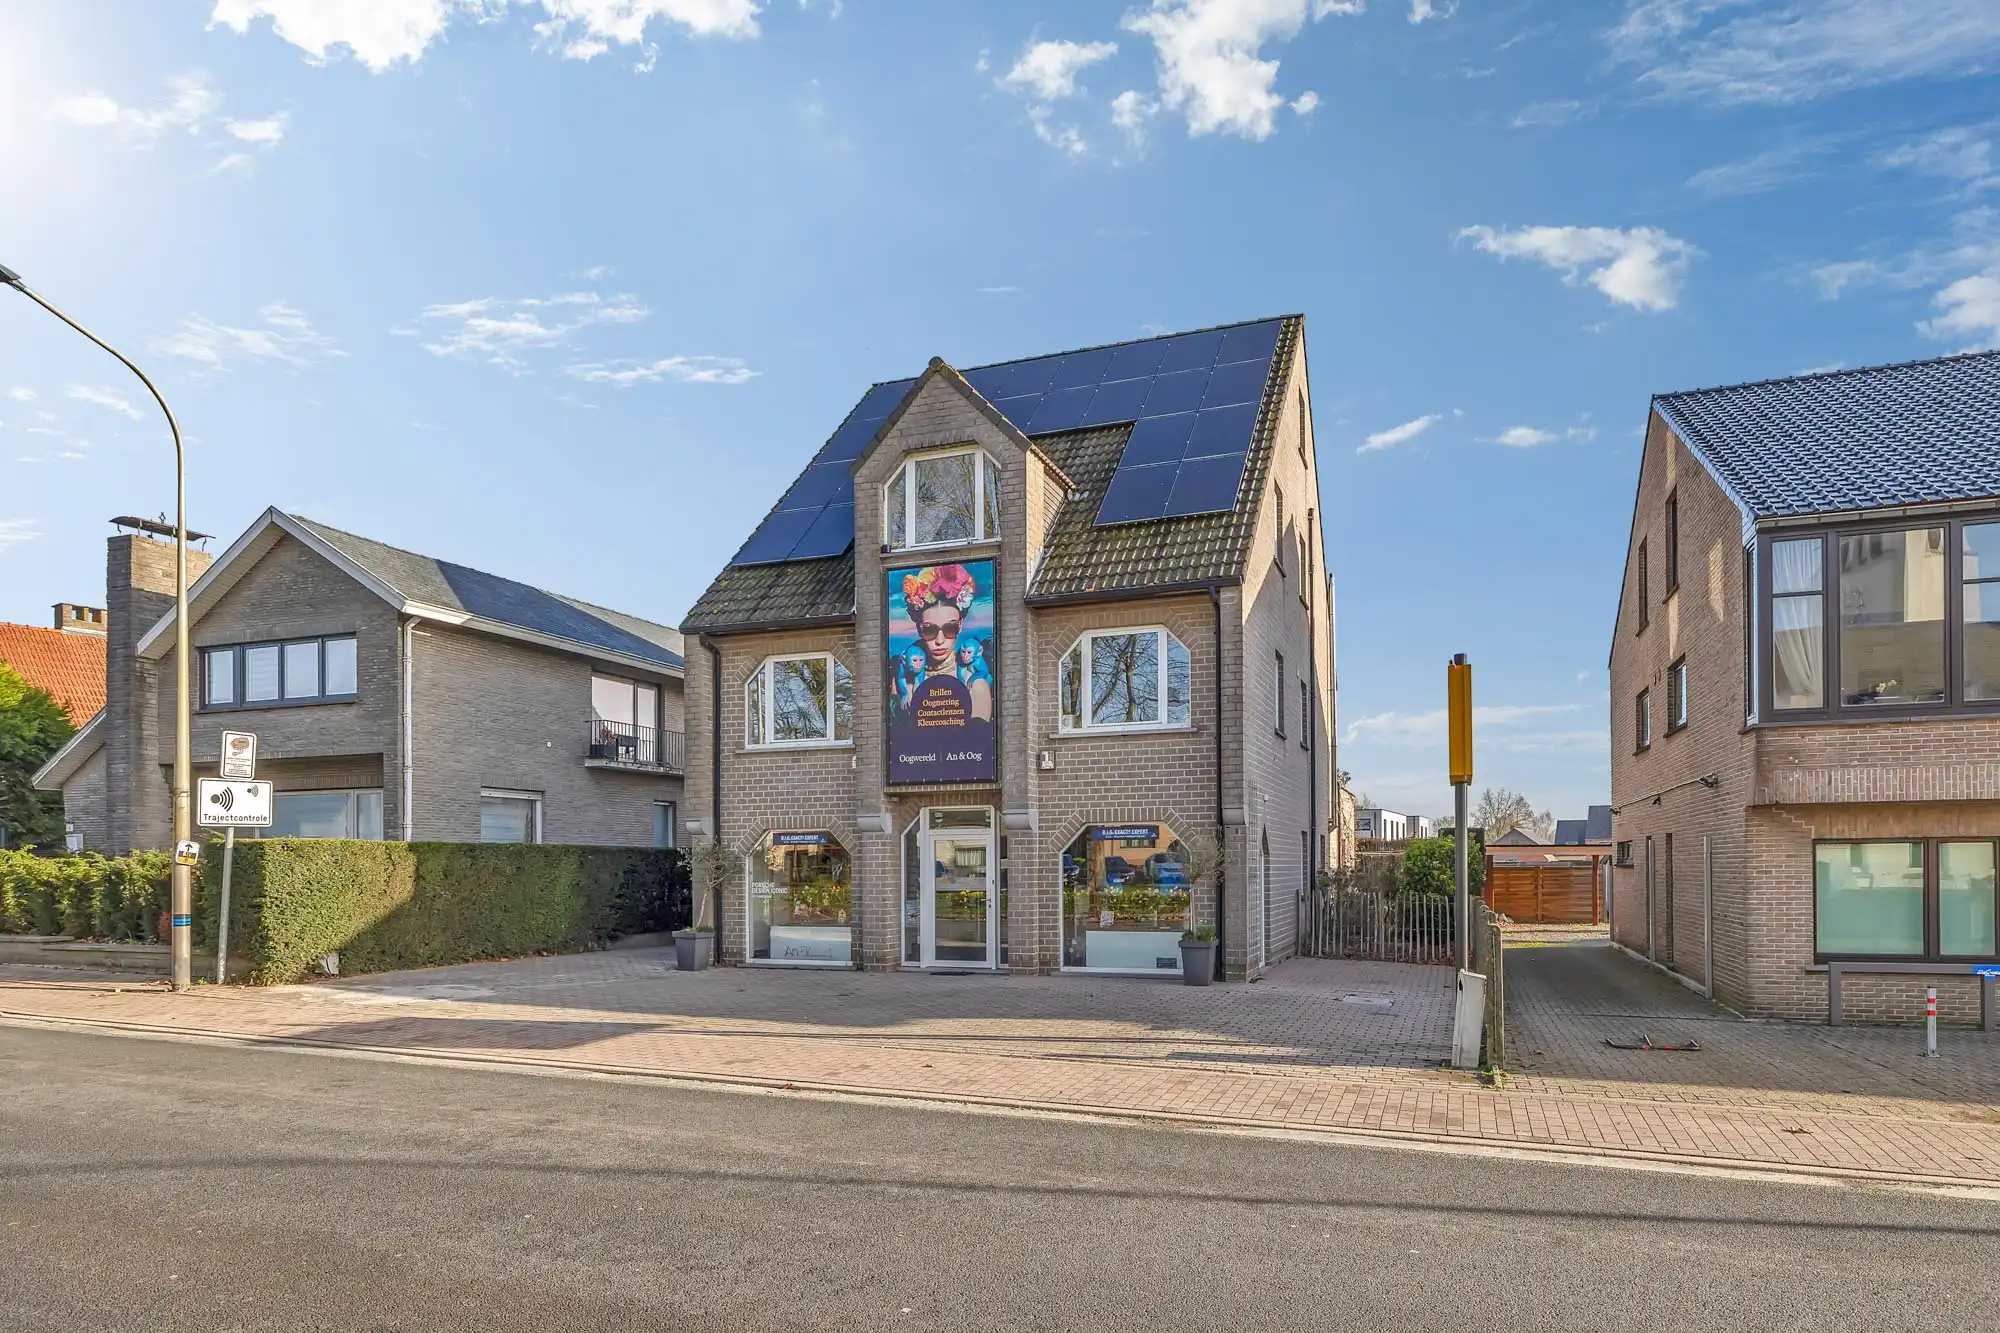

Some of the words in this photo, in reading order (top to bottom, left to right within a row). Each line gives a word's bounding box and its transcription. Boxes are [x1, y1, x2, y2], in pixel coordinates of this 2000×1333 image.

[929, 688, 952, 697] Brillen
[922, 698, 959, 708] Oogmeting
[917, 708, 964, 717] Contactlenzen
[917, 717, 965, 727] Kleurcoaching
[899, 752, 936, 764] Oogwereld
[946, 752, 958, 761] An
[959, 751, 965, 760] &
[966, 751, 982, 761] Oog
[203, 813, 268, 822] Trajectcontrole
